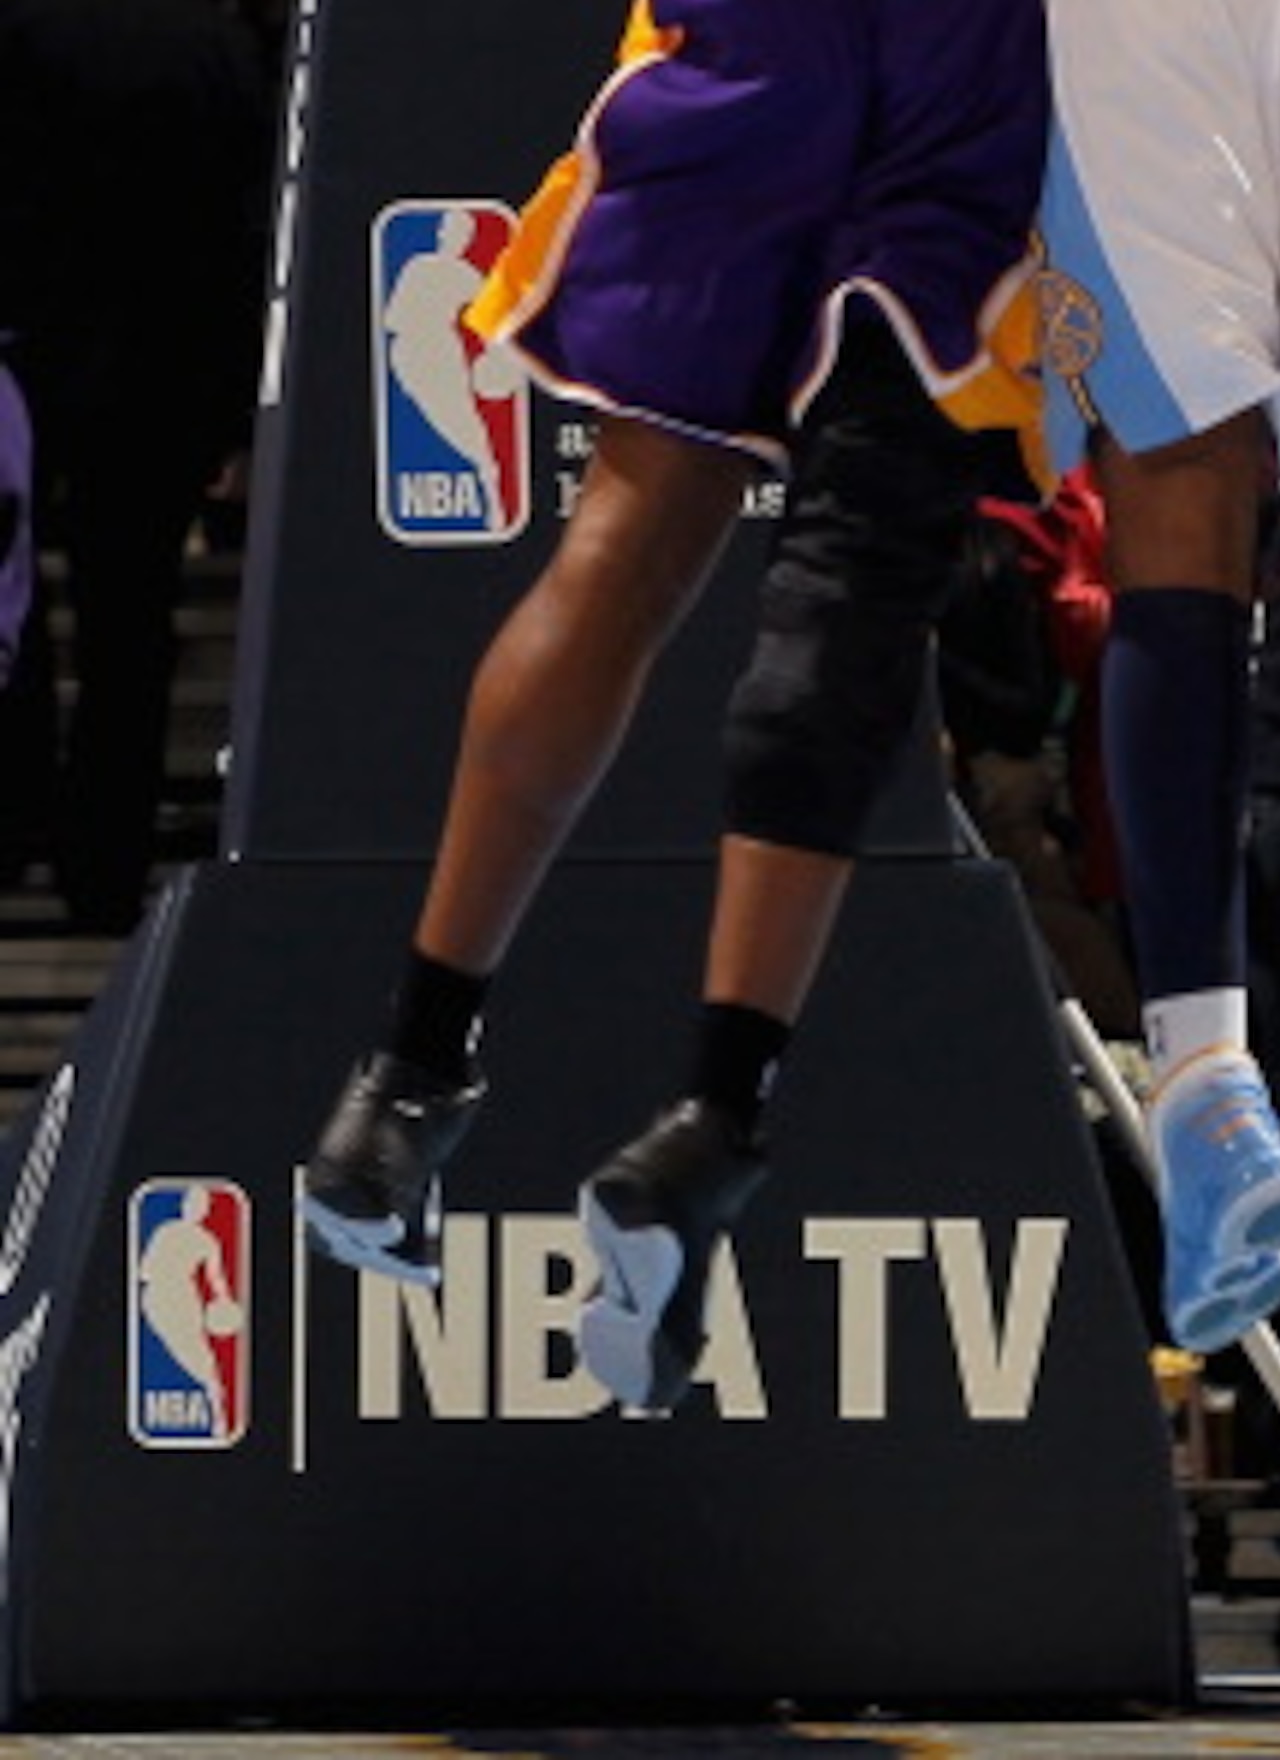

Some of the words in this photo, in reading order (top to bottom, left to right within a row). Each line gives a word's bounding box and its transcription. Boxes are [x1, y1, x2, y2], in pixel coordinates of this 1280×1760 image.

[398, 472, 481, 520] NBA
[356, 1212, 770, 1421] NBA
[802, 1216, 1069, 1421] TV
[144, 1390, 210, 1428] NBA
